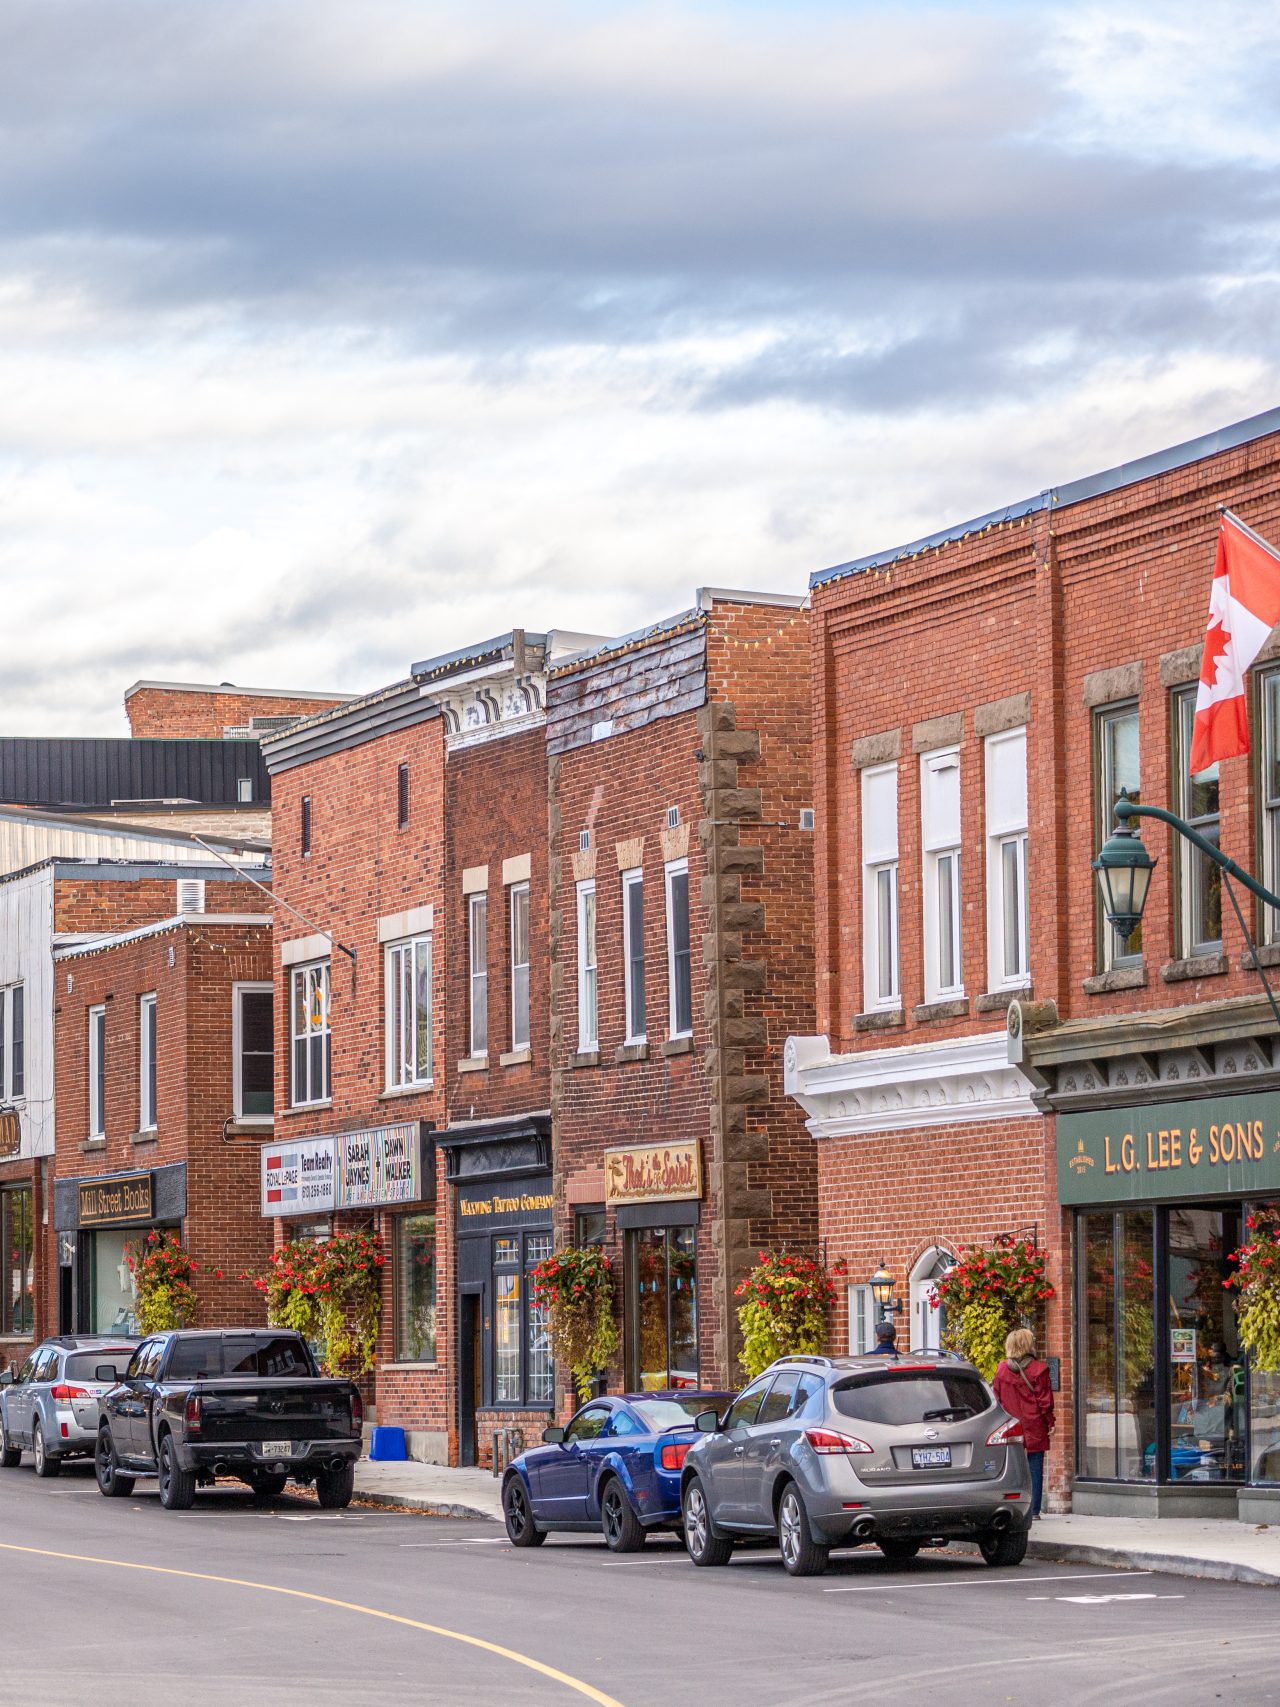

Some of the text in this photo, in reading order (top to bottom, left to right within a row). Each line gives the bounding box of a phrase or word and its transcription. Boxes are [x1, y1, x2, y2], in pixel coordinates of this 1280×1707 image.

[348, 1142, 369, 1163] SARAH
[384, 1137, 404, 1158] DAWN
[1104, 1133, 1141, 1173] L.G.
[1146, 1129, 1183, 1169] LEE
[1188, 1127, 1204, 1166] &
[1209, 1120, 1265, 1163] SONS
[301, 1149, 333, 1173] Team Realty
[385, 1160, 411, 1181] WALKER
[266, 1171, 281, 1187] ROYAL
[345, 1166, 370, 1187] JAYNES
[80, 1184, 149, 1216] Mill Street Books
